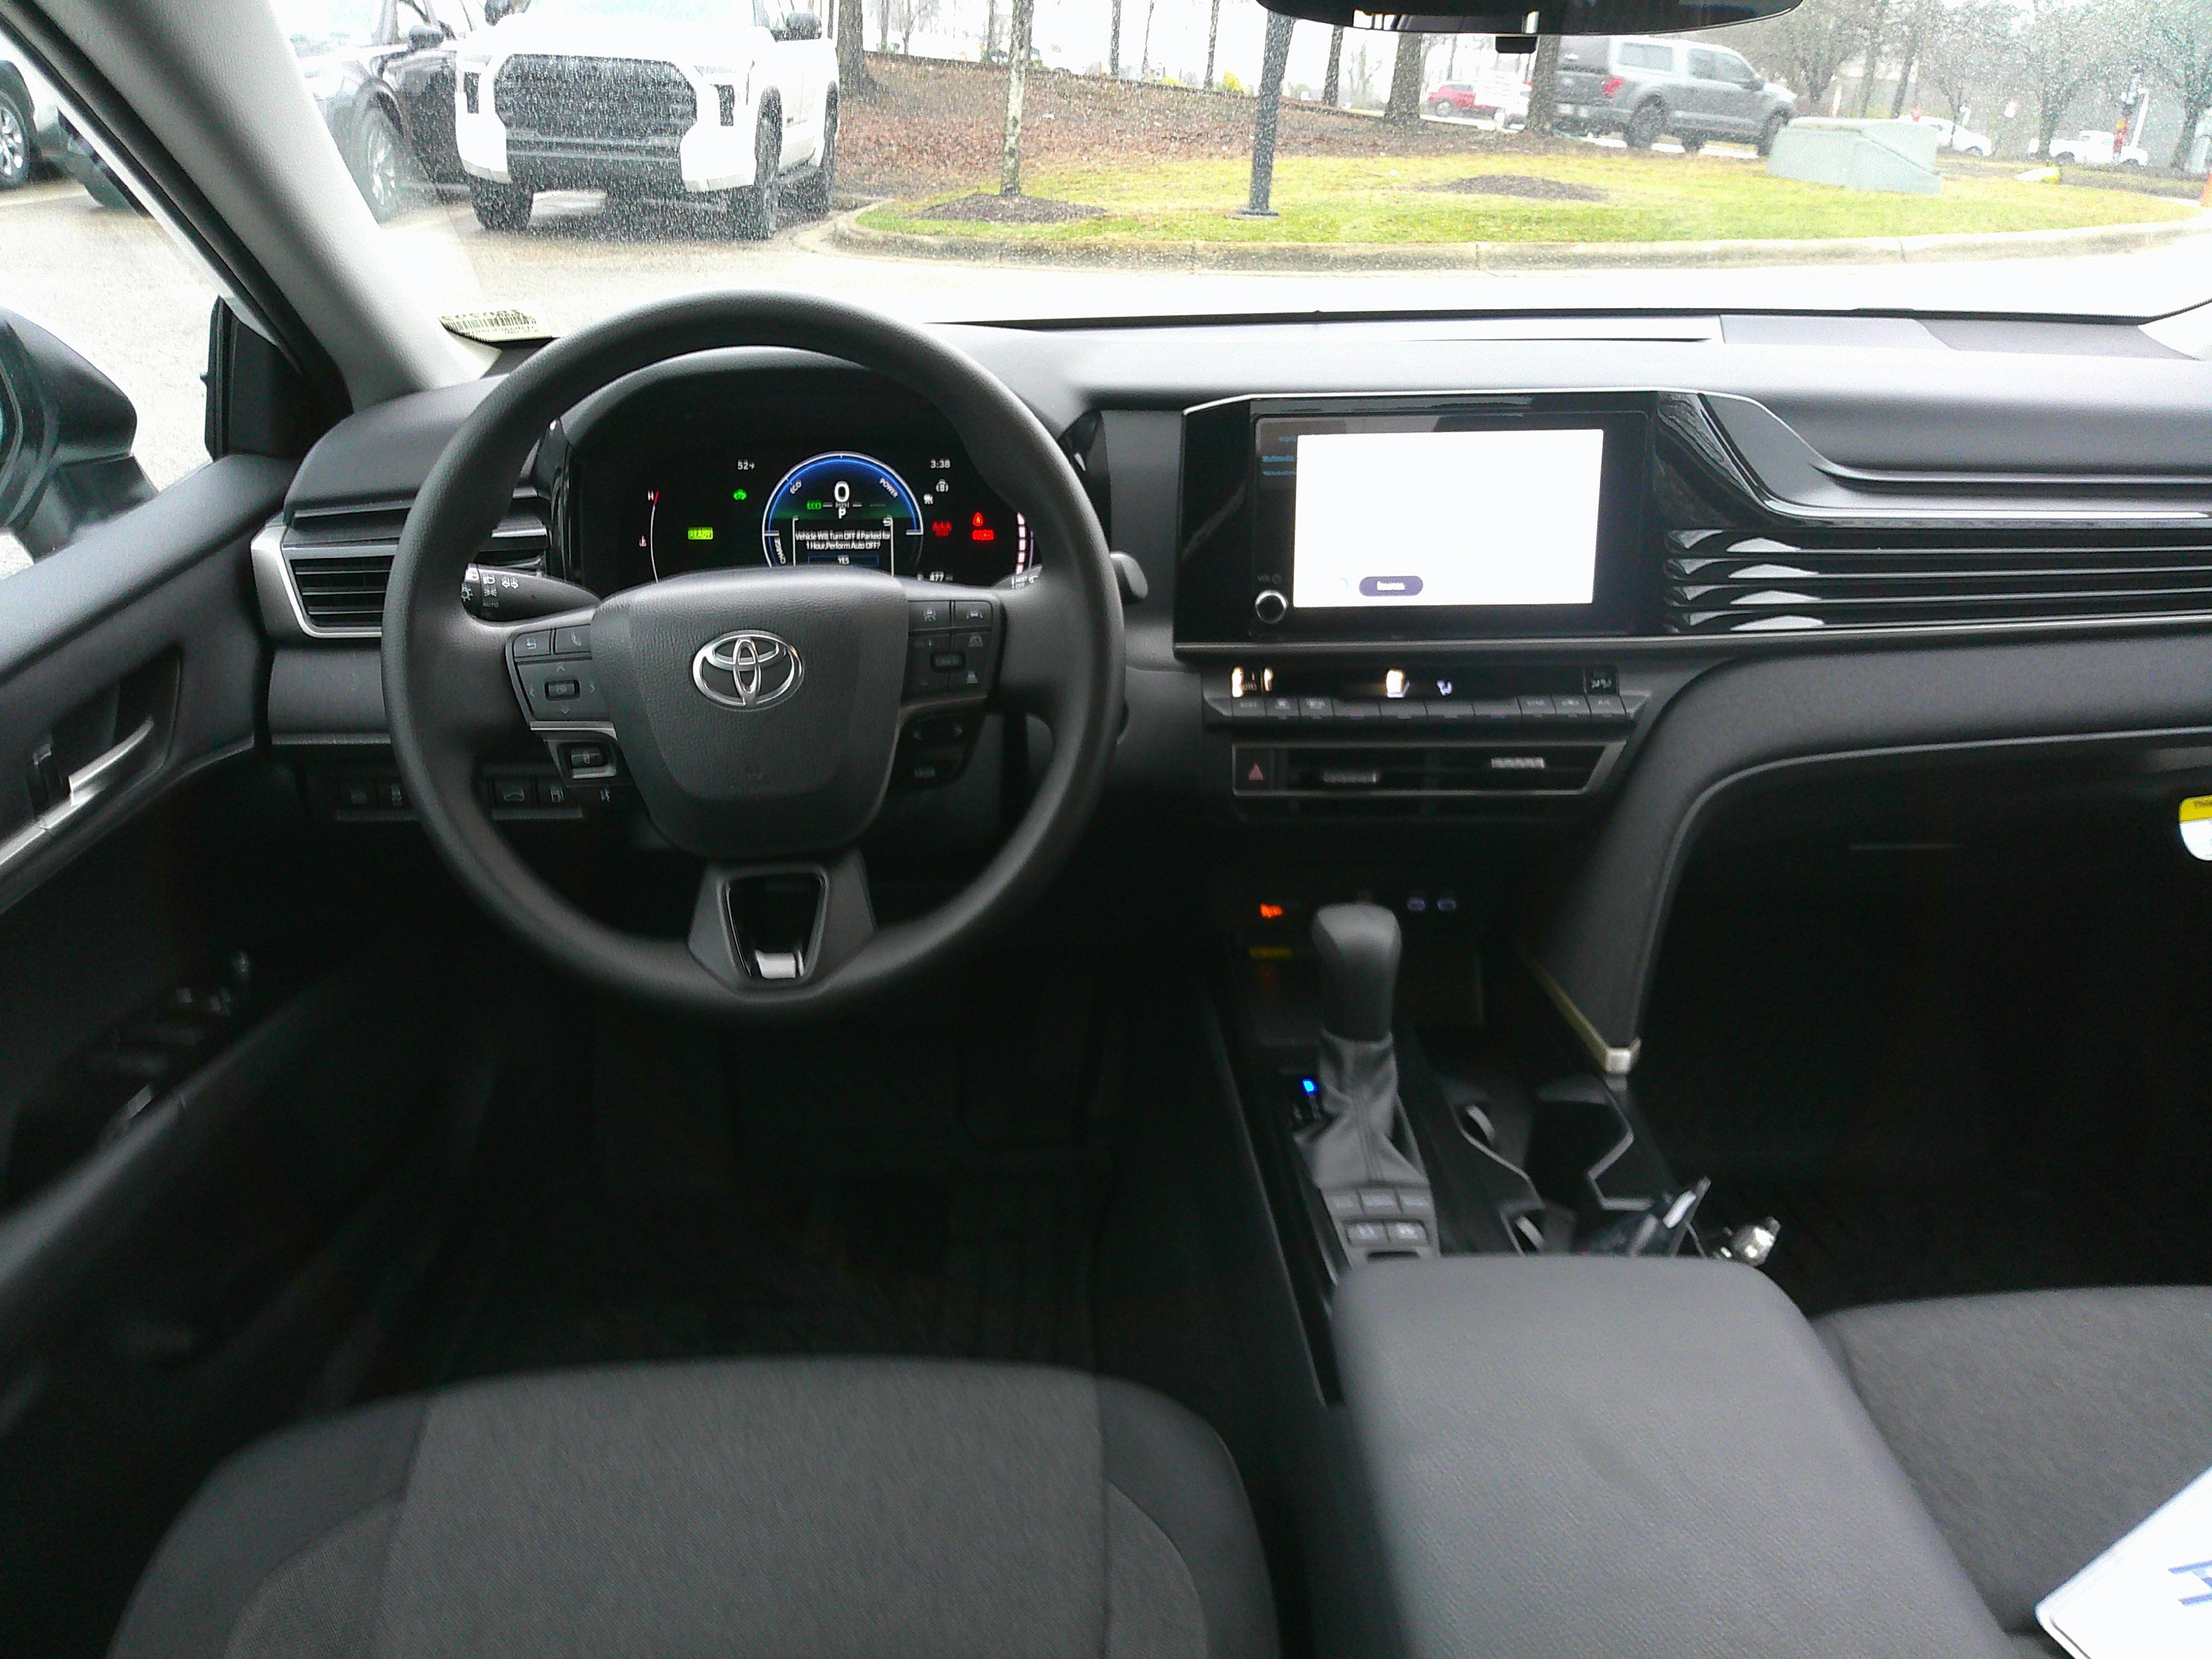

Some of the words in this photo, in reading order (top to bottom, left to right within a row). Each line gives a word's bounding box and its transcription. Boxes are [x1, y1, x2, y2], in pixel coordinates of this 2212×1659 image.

[930, 458, 951, 468] 3:38
[834, 481, 850, 503] 0
[879, 477, 899, 498] POWER
[806, 500, 822, 510] ECO
[838, 506, 847, 519] P
[795, 530, 817, 540] Vehicle
[817, 530, 829, 540] Will
[830, 530, 843, 540] Turn
[844, 530, 855, 540] OFF
[860, 529, 881, 540] Parked
[882, 529, 891, 540] for
[774, 536, 786, 564] CHARGE
[851, 540, 865, 550] Auto
[837, 555, 850, 565] YES
